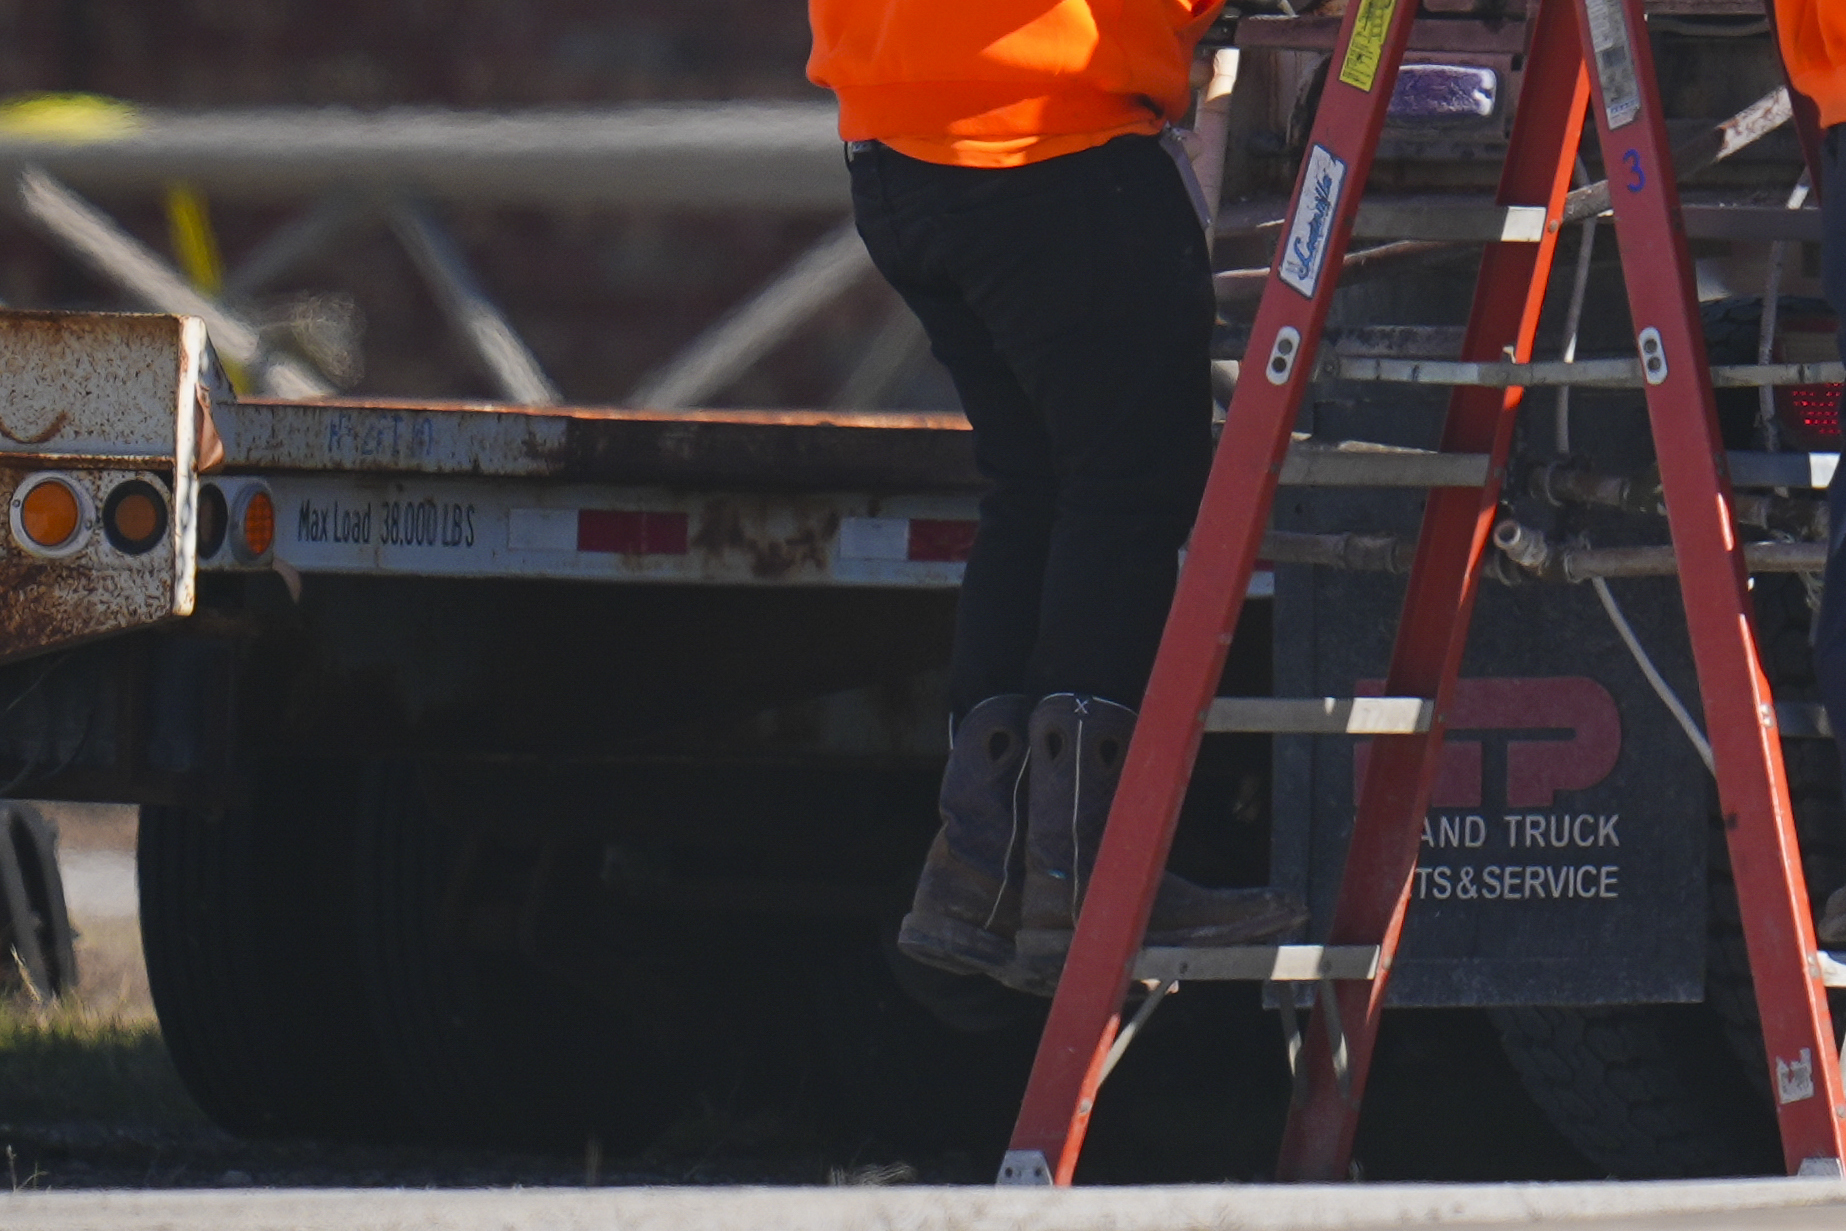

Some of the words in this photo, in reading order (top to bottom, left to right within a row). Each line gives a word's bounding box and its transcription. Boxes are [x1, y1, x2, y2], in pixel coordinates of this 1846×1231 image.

[1623, 148, 1646, 192] 3
[298, 499, 328, 543] Max
[334, 499, 371, 544] Load
[440, 502, 475, 547] LBS
[1420, 816, 1486, 848] AND
[1503, 815, 1620, 848] TRUCK
[1414, 866, 1620, 900] TS&SERVICE
